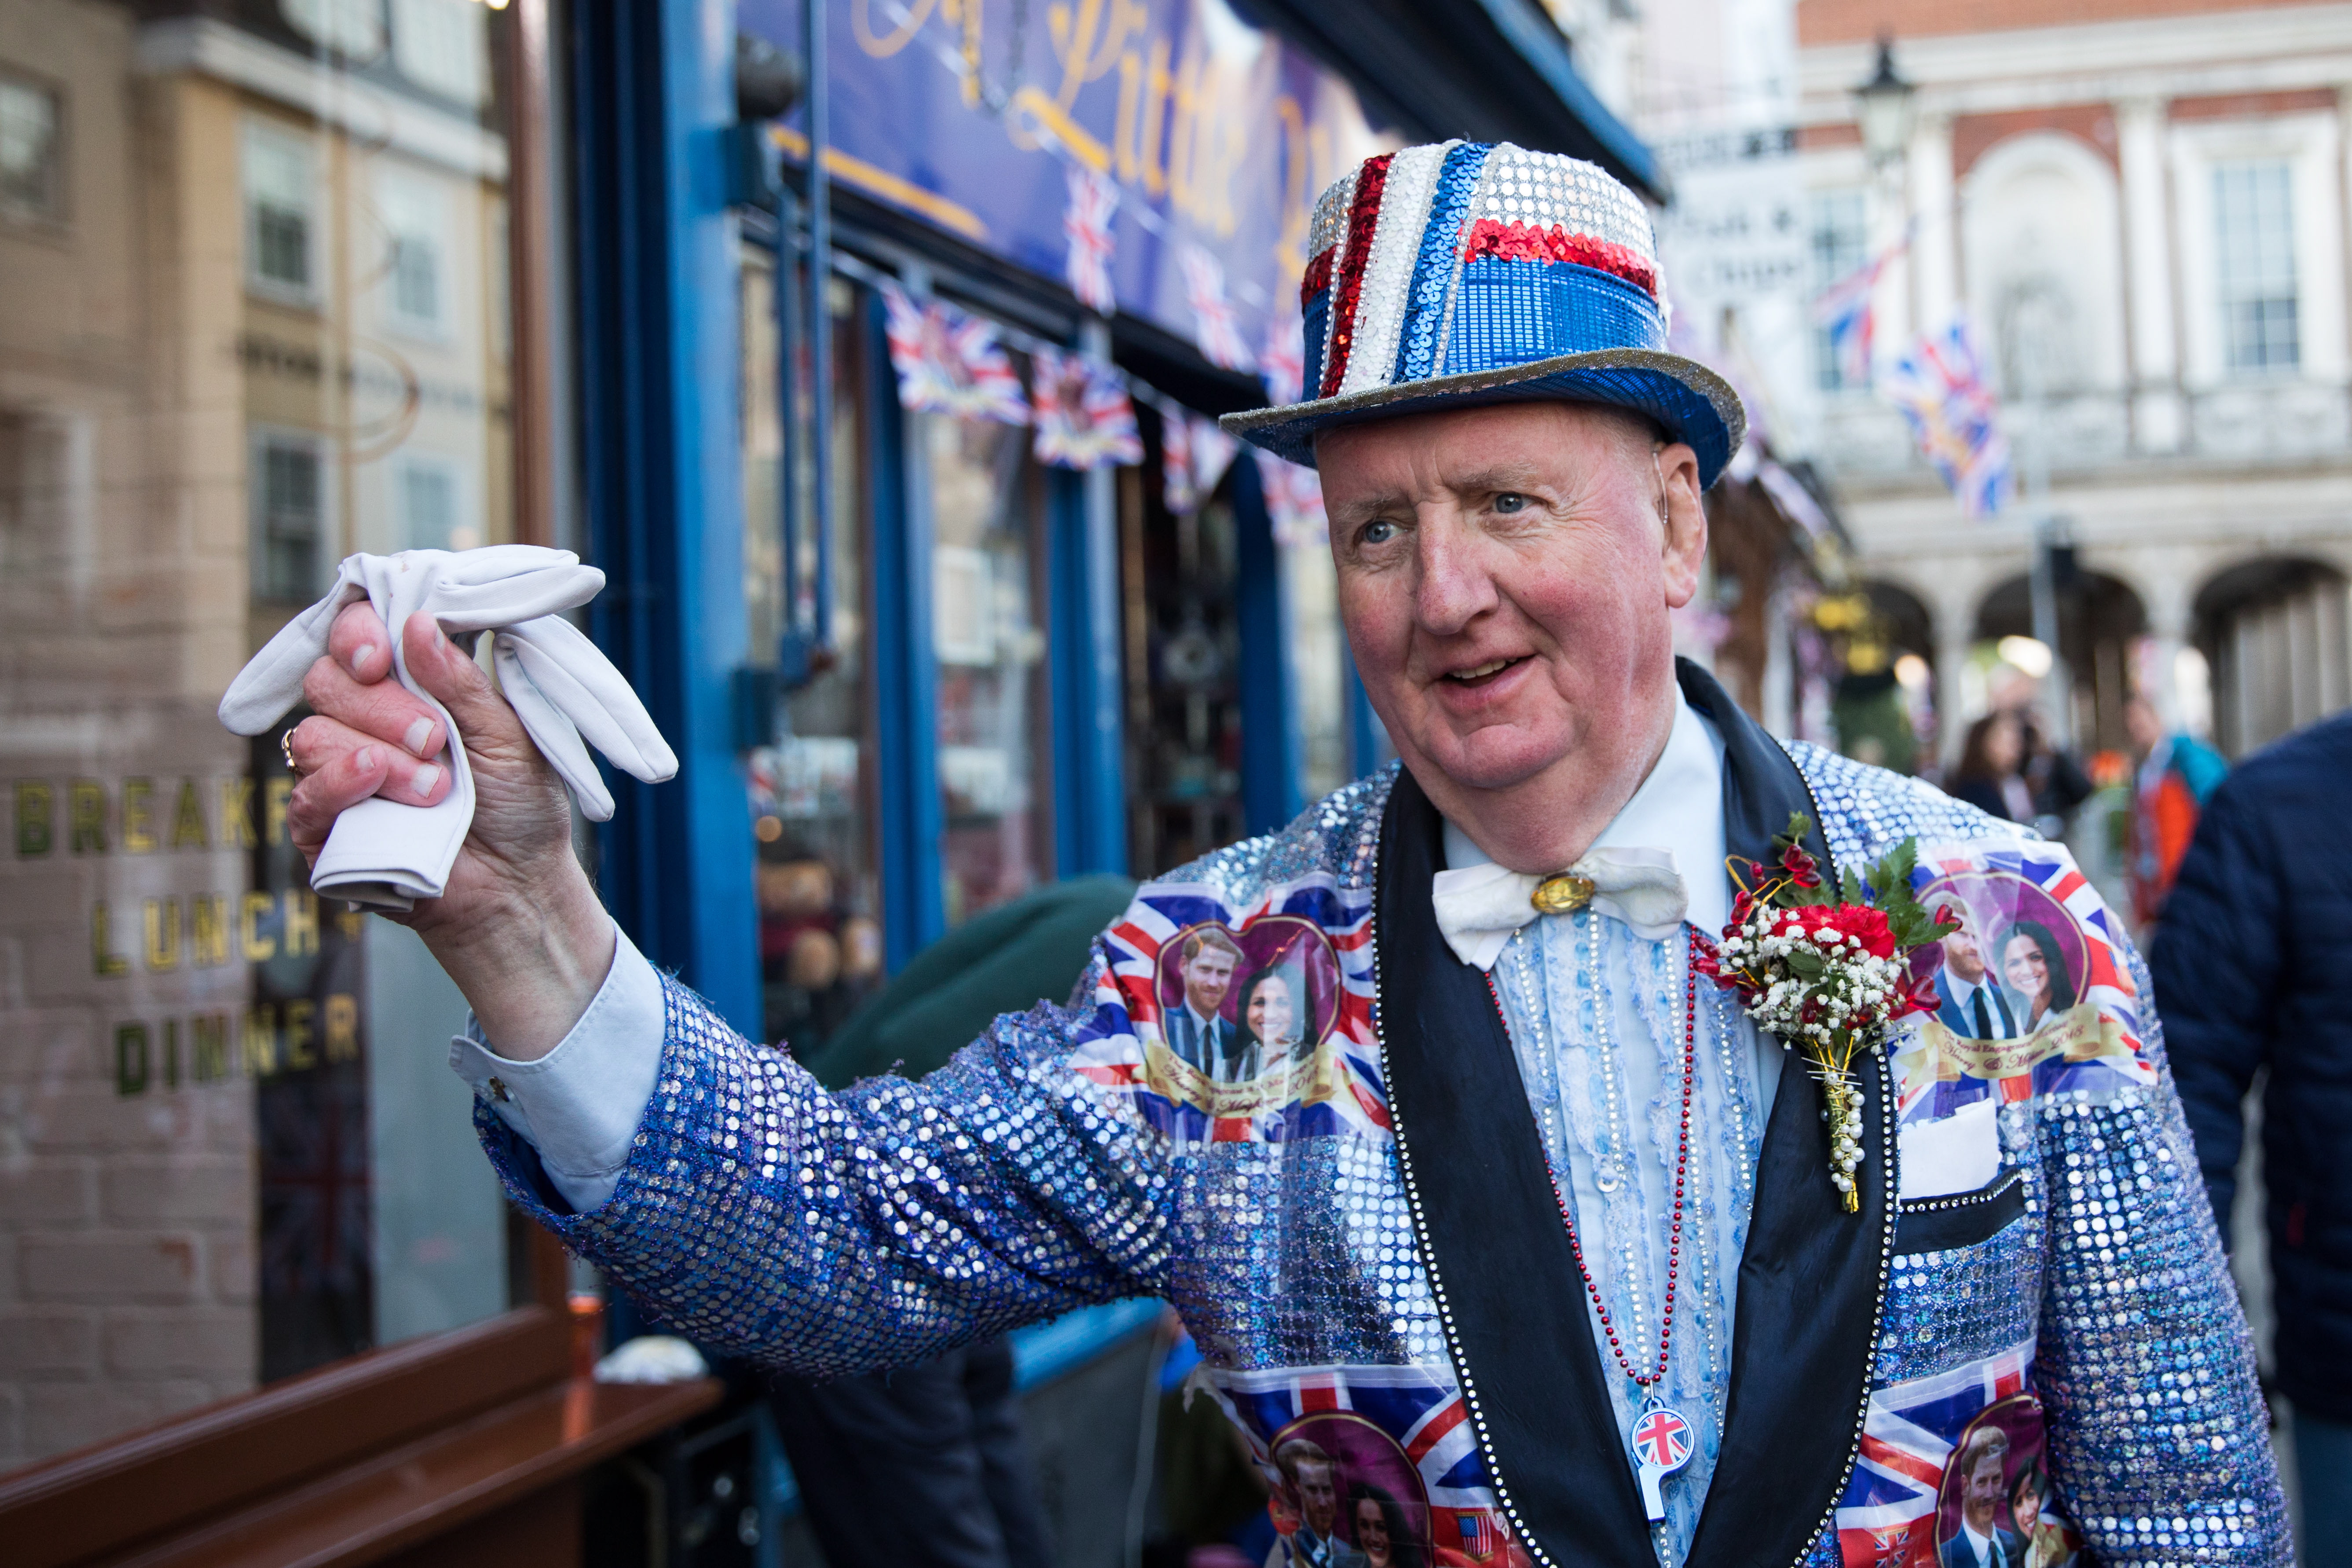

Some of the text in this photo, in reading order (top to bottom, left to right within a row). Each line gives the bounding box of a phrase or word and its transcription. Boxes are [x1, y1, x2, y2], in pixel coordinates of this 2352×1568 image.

[15, 777, 294, 856] BREAKF
[94, 888, 320, 975] LUNCH
[116, 993, 358, 1095] DINNER
[1942, 1040, 1976, 1071] Harry
[2050, 1024, 2085, 1051] 2018
